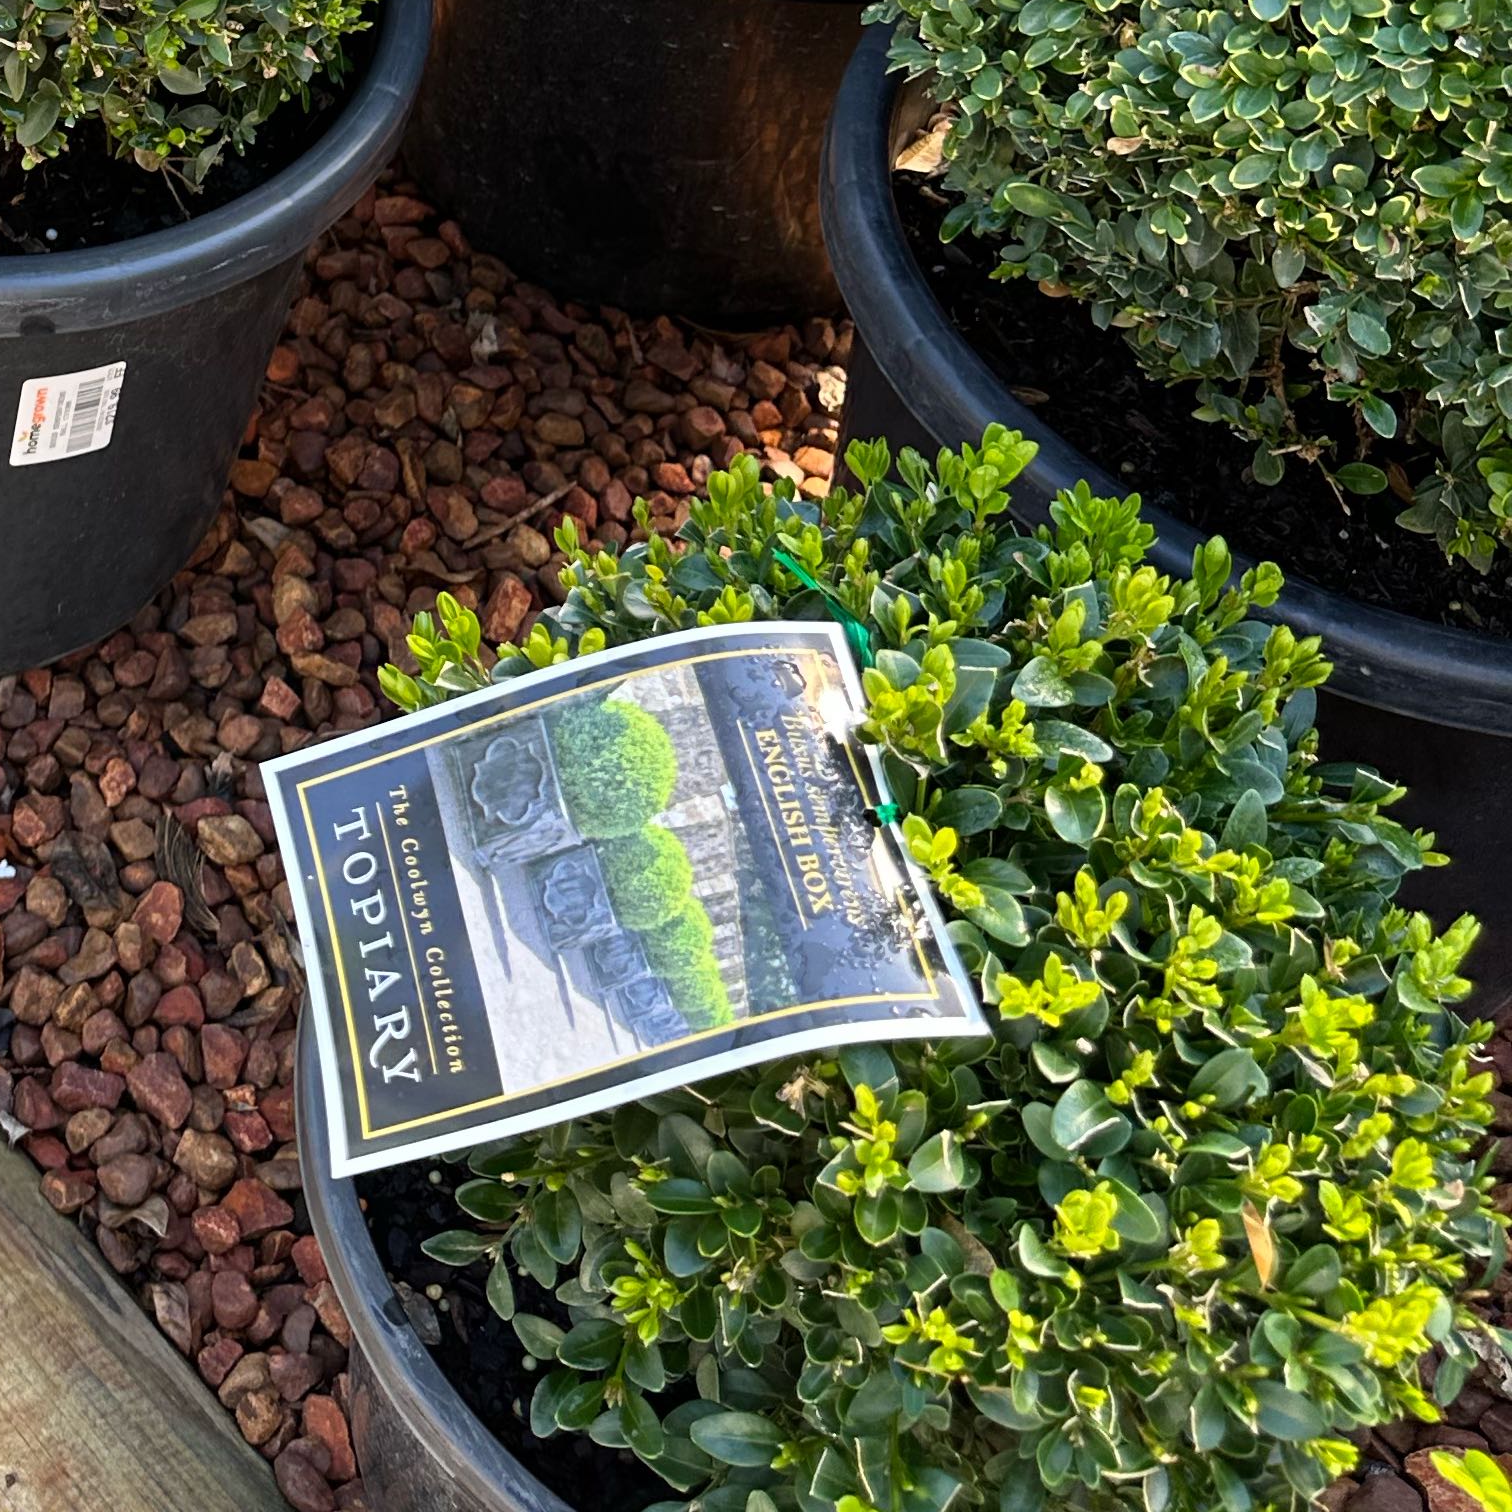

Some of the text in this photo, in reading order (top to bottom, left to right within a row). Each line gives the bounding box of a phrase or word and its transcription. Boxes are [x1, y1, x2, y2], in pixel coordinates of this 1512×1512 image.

[22, 386, 48, 456] homegrown
[388, 784, 467, 1075] The Coolwyn Collection
[754, 728, 835, 915] ENGLISH BOX
[333, 806, 423, 1084] TOPIARY
